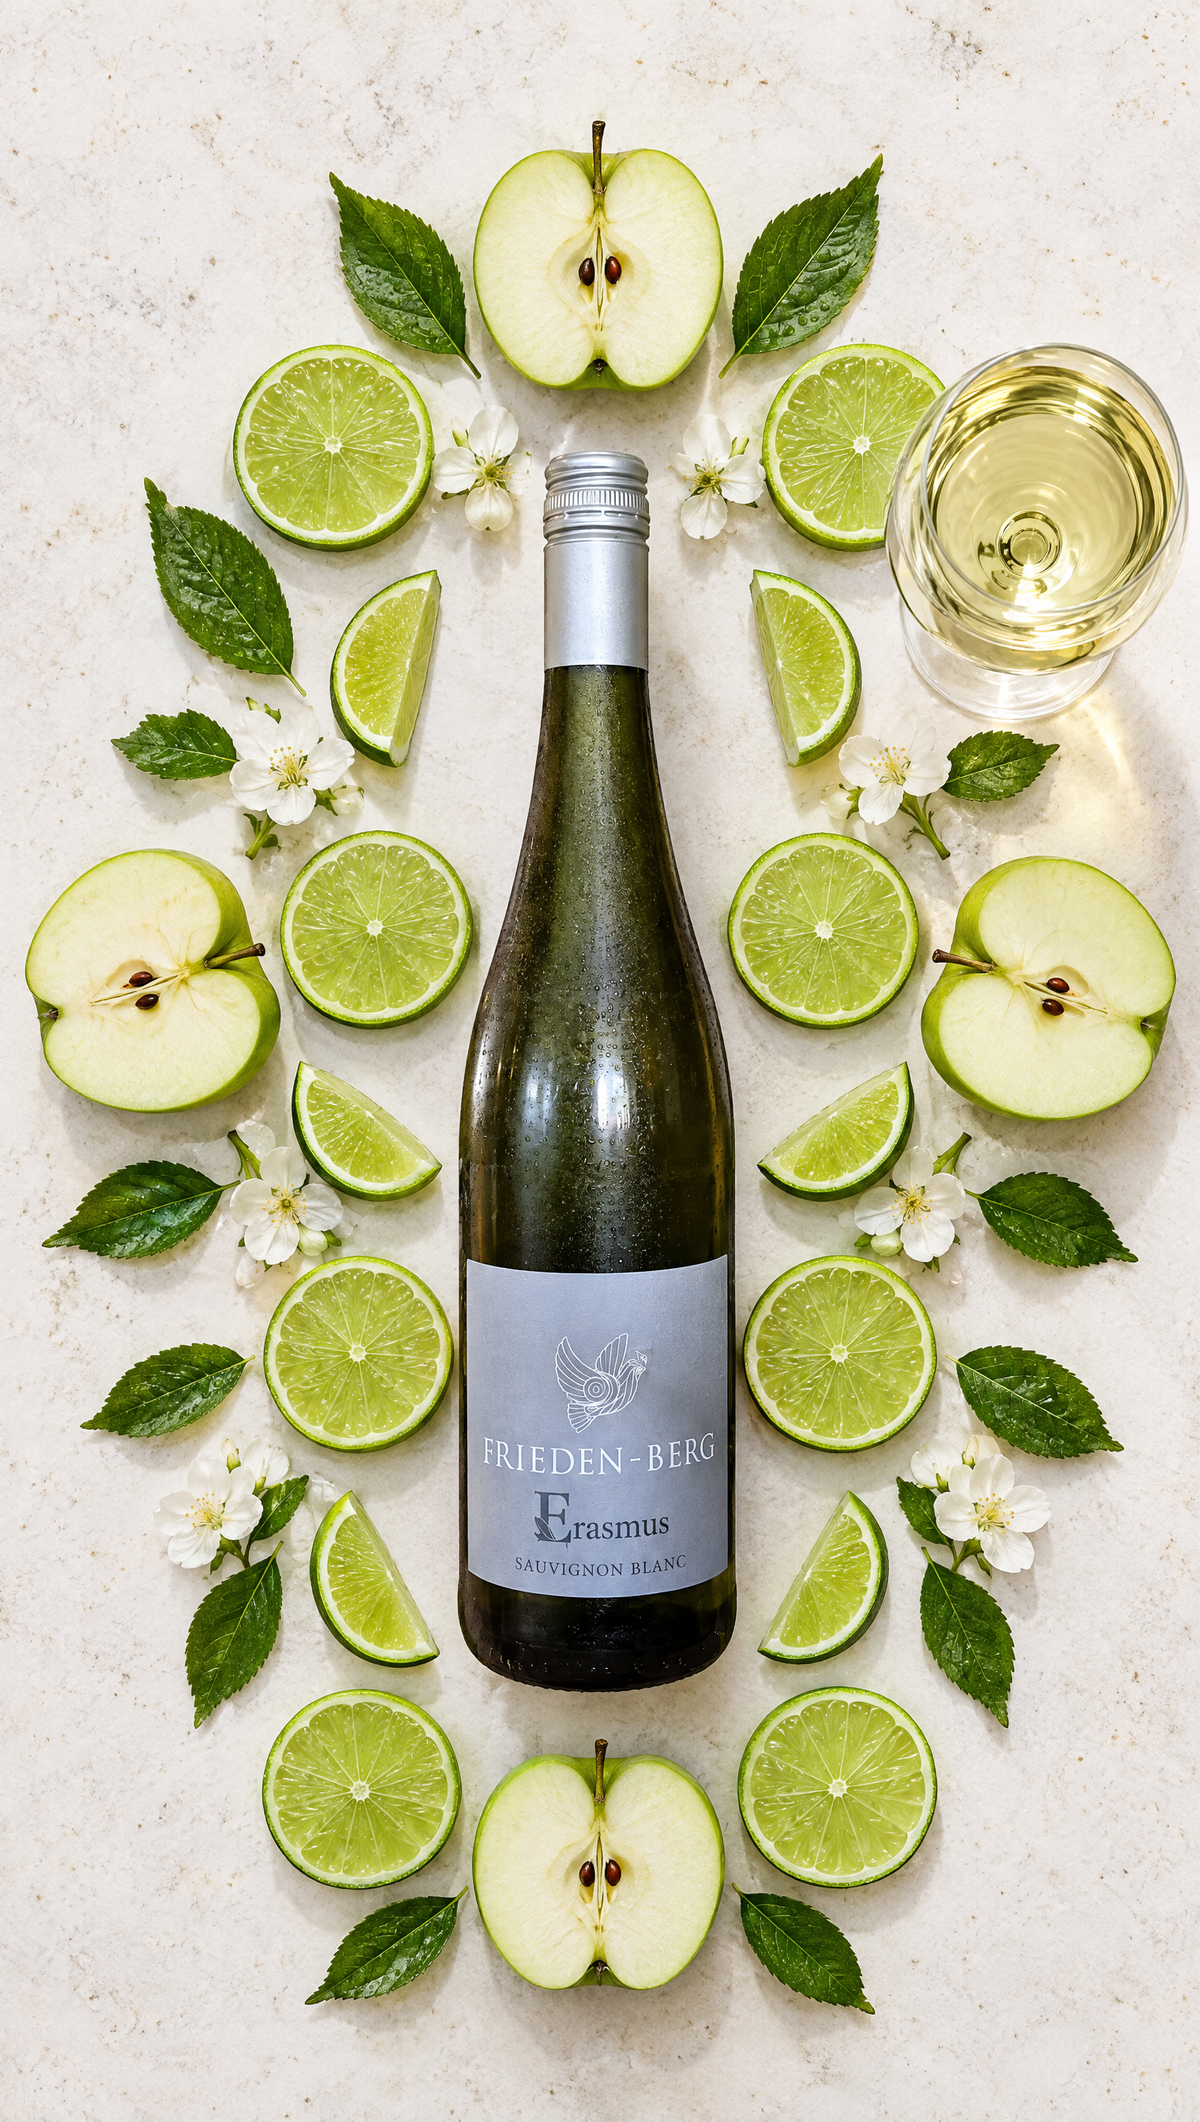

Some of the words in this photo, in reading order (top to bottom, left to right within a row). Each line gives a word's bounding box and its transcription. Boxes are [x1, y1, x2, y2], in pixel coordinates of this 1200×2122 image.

[534, 1490, 670, 1548] Erasmus
[514, 1556, 623, 1577] SAUVIGNON
[631, 1554, 687, 1576] BLANC
